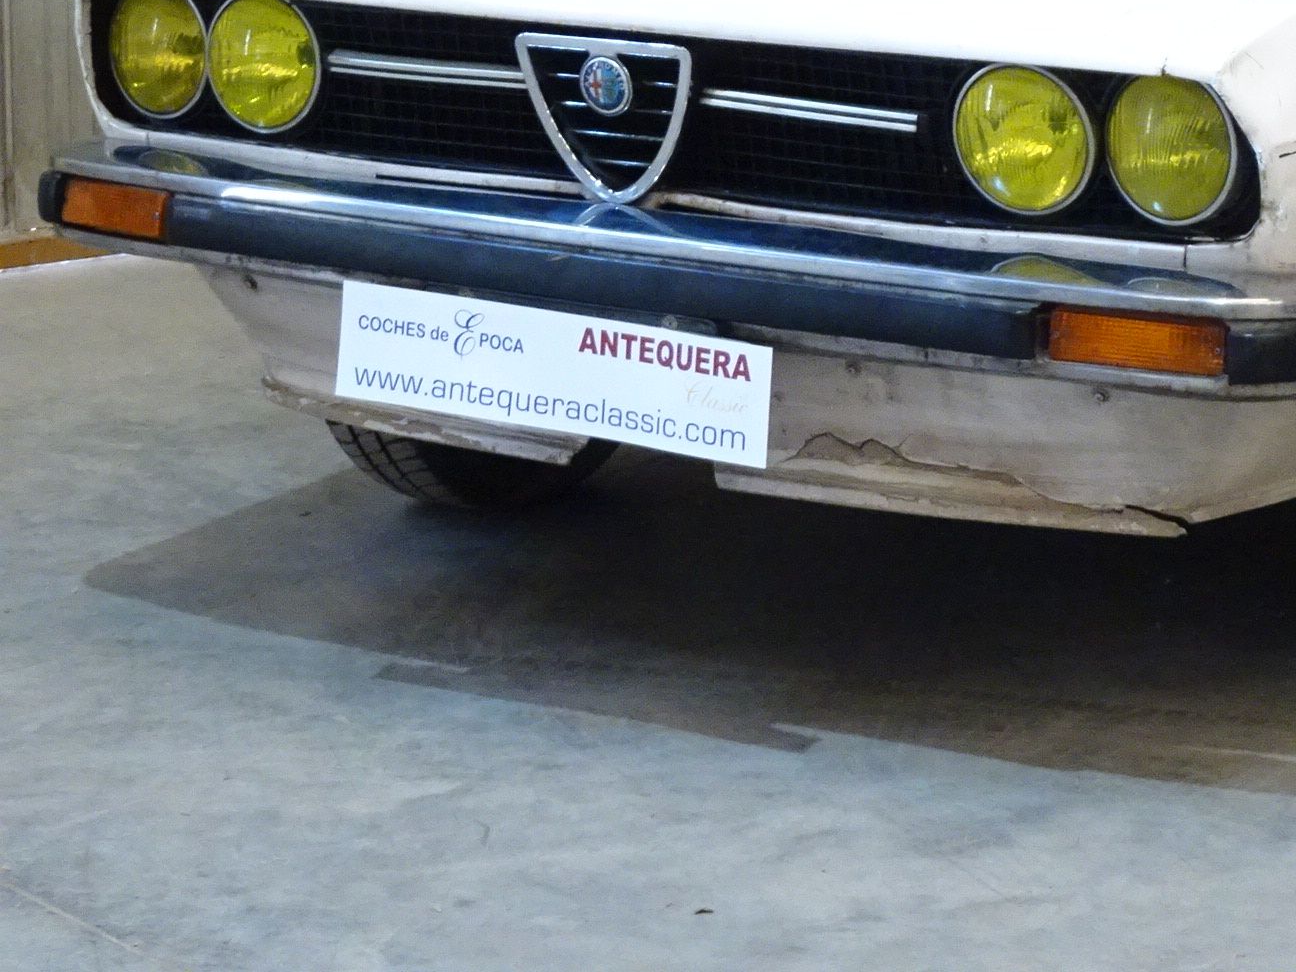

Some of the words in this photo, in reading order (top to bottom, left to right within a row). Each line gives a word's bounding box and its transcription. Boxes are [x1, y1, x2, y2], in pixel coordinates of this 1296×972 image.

[358, 314, 426, 338] COCHES
[430, 326, 449, 342] de
[579, 327, 751, 381] ANTEQUERA
[354, 366, 746, 450] www.antequeraclassic.com
